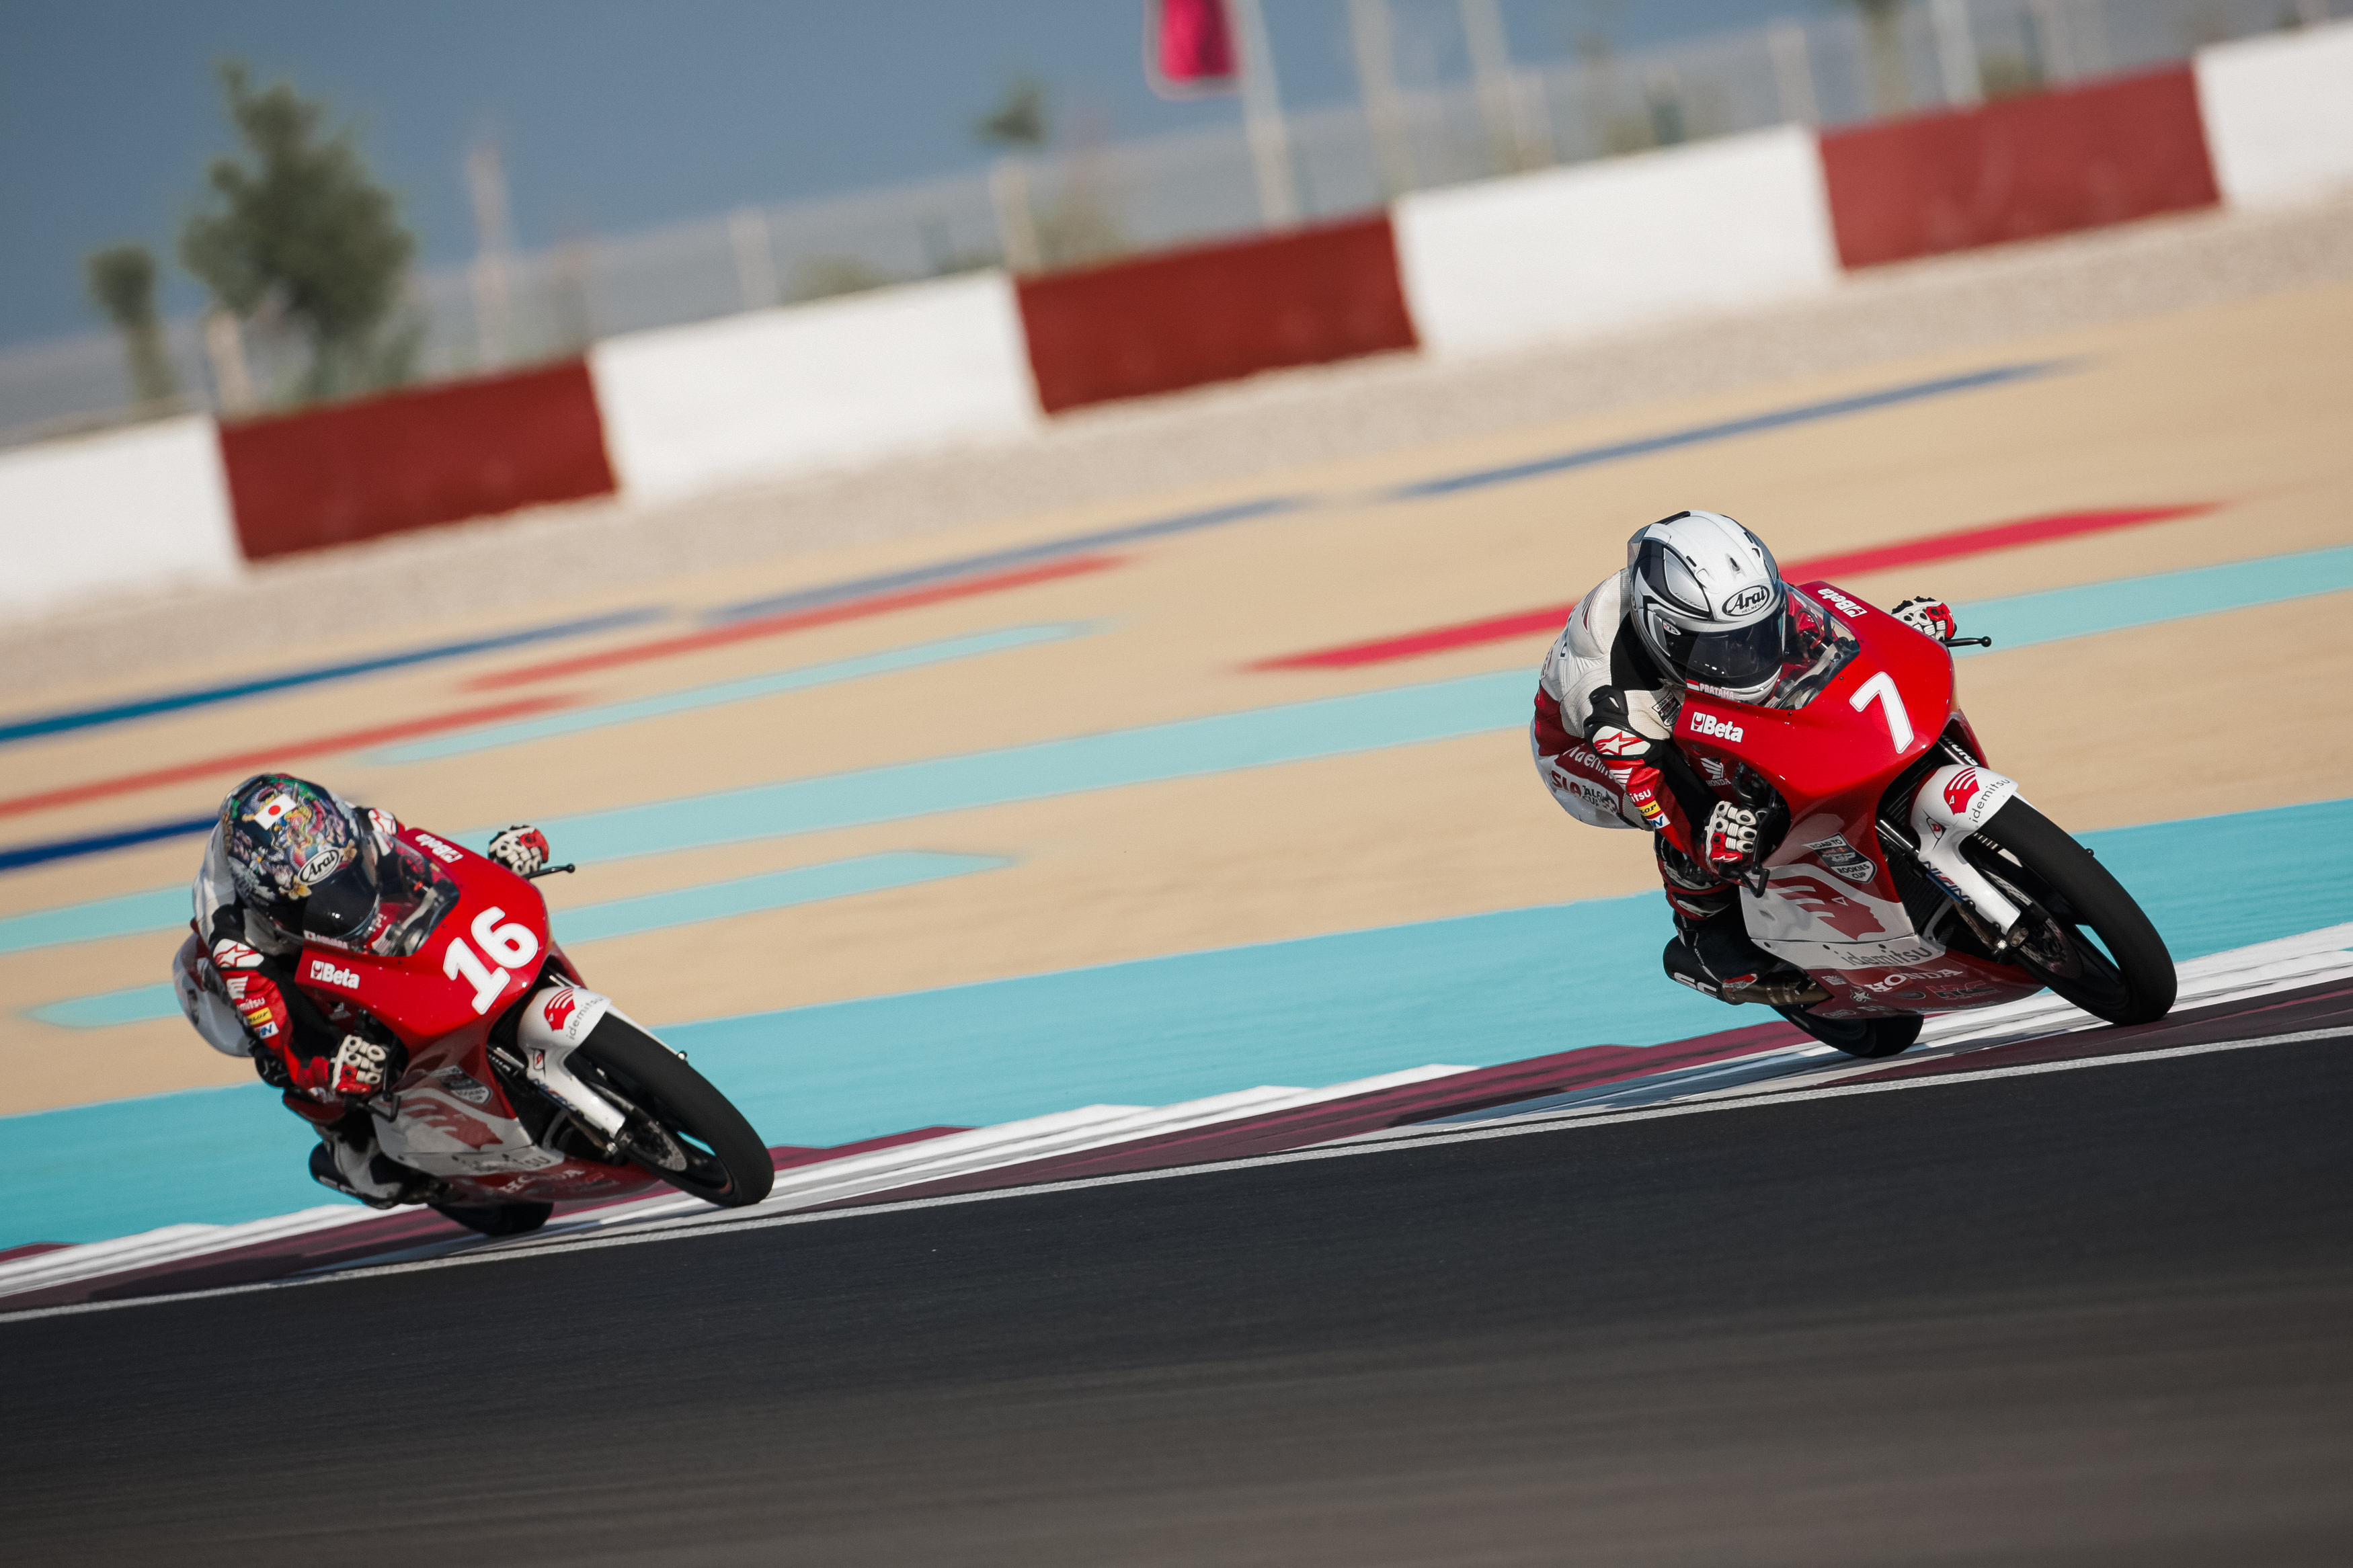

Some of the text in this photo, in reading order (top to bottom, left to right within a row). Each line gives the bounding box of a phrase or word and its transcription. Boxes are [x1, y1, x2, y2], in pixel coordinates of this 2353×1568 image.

[1726, 585, 1767, 614] Arai
[1817, 587, 1858, 611] Beta
[1699, 682, 1734, 699] PRATAMA
[1849, 671, 1915, 754] 7
[1702, 714, 1744, 743] Beta
[1551, 770, 1582, 797] SIA
[1629, 788, 1652, 802] itsu
[1705, 778, 1732, 787] HONDA
[1640, 804, 1657, 814] LOP
[1969, 778, 2011, 823] idemitsu
[302, 851, 336, 882] Arai
[1836, 864, 1870, 874] ROOKIES
[442, 906, 539, 1015] 16
[1835, 946, 1933, 966] idemitsu
[322, 962, 360, 990] Beta
[1864, 968, 1963, 993] HONDA
[565, 997, 604, 1041] idemitsu
